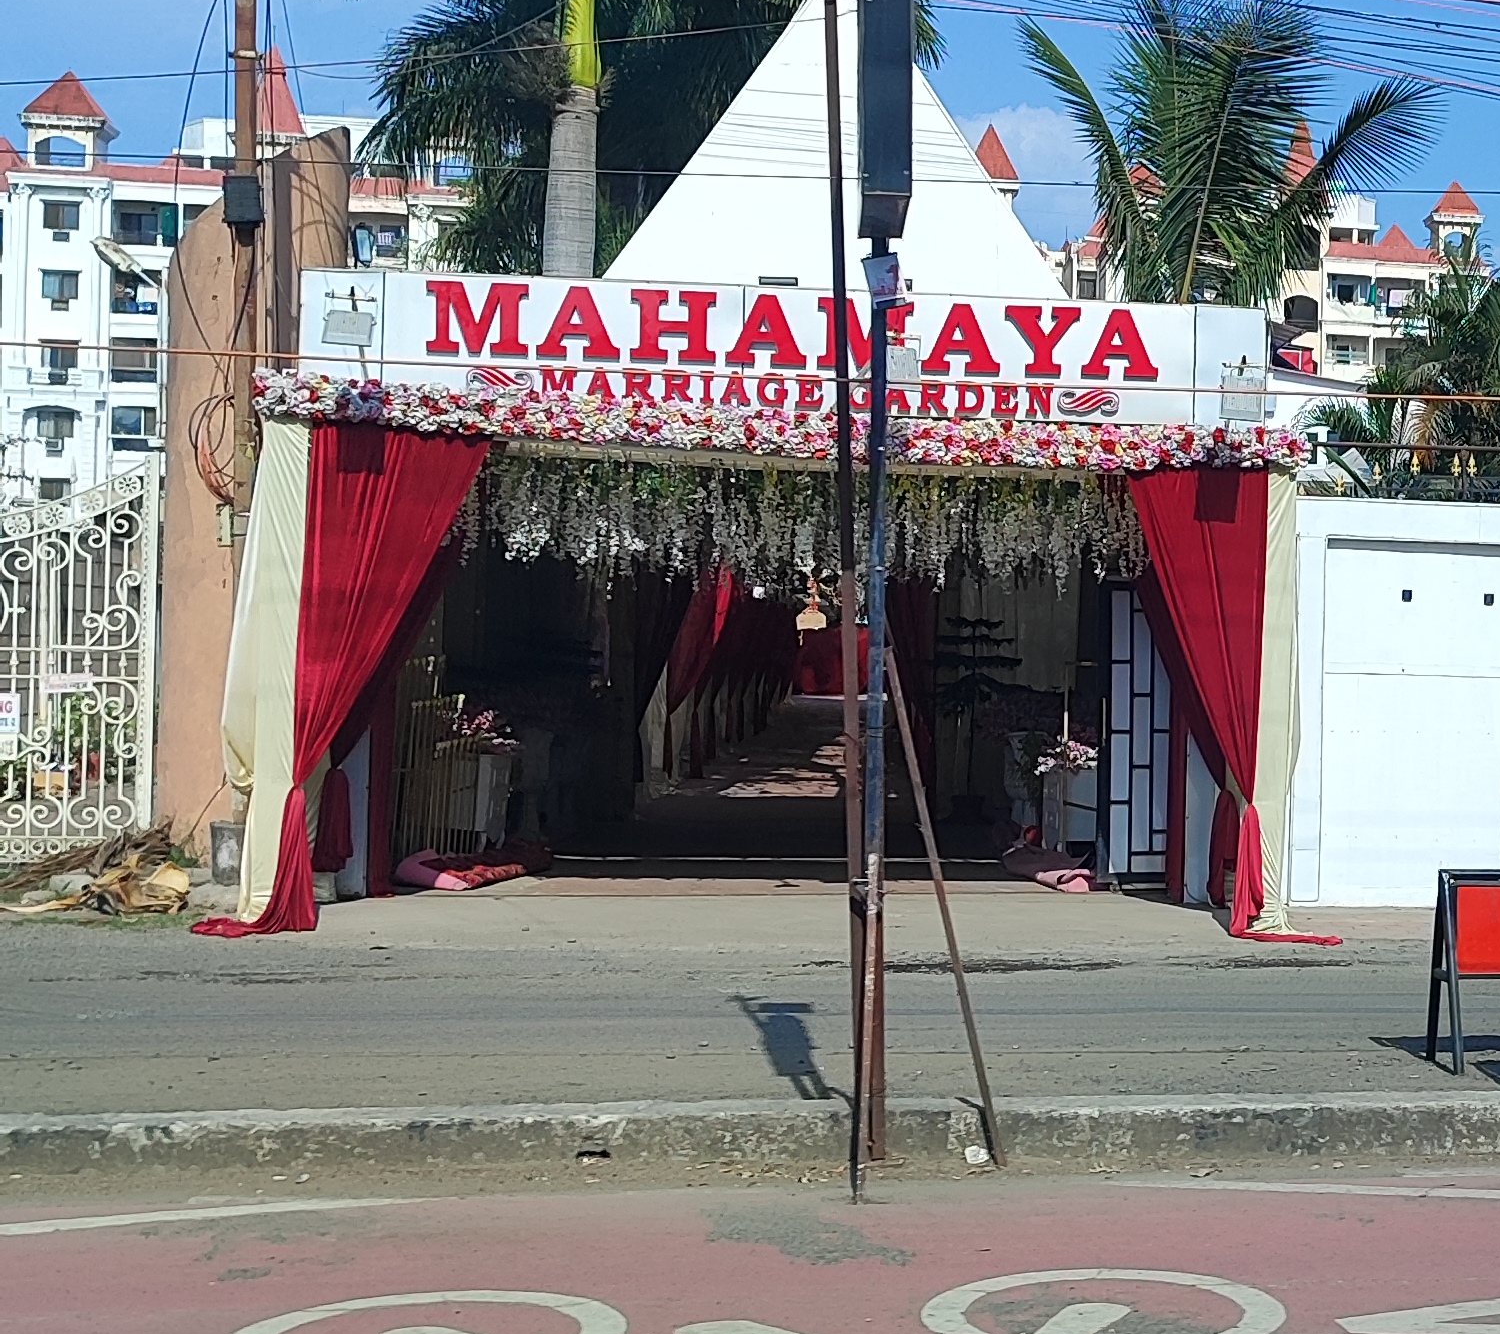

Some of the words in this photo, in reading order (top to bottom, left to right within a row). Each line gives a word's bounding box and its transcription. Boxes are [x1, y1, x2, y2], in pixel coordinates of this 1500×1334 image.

[426, 280, 1159, 381] MAHAMAYA
[540, 365, 824, 412] MARRIAGE
[849, 379, 1054, 419] GARDEN
